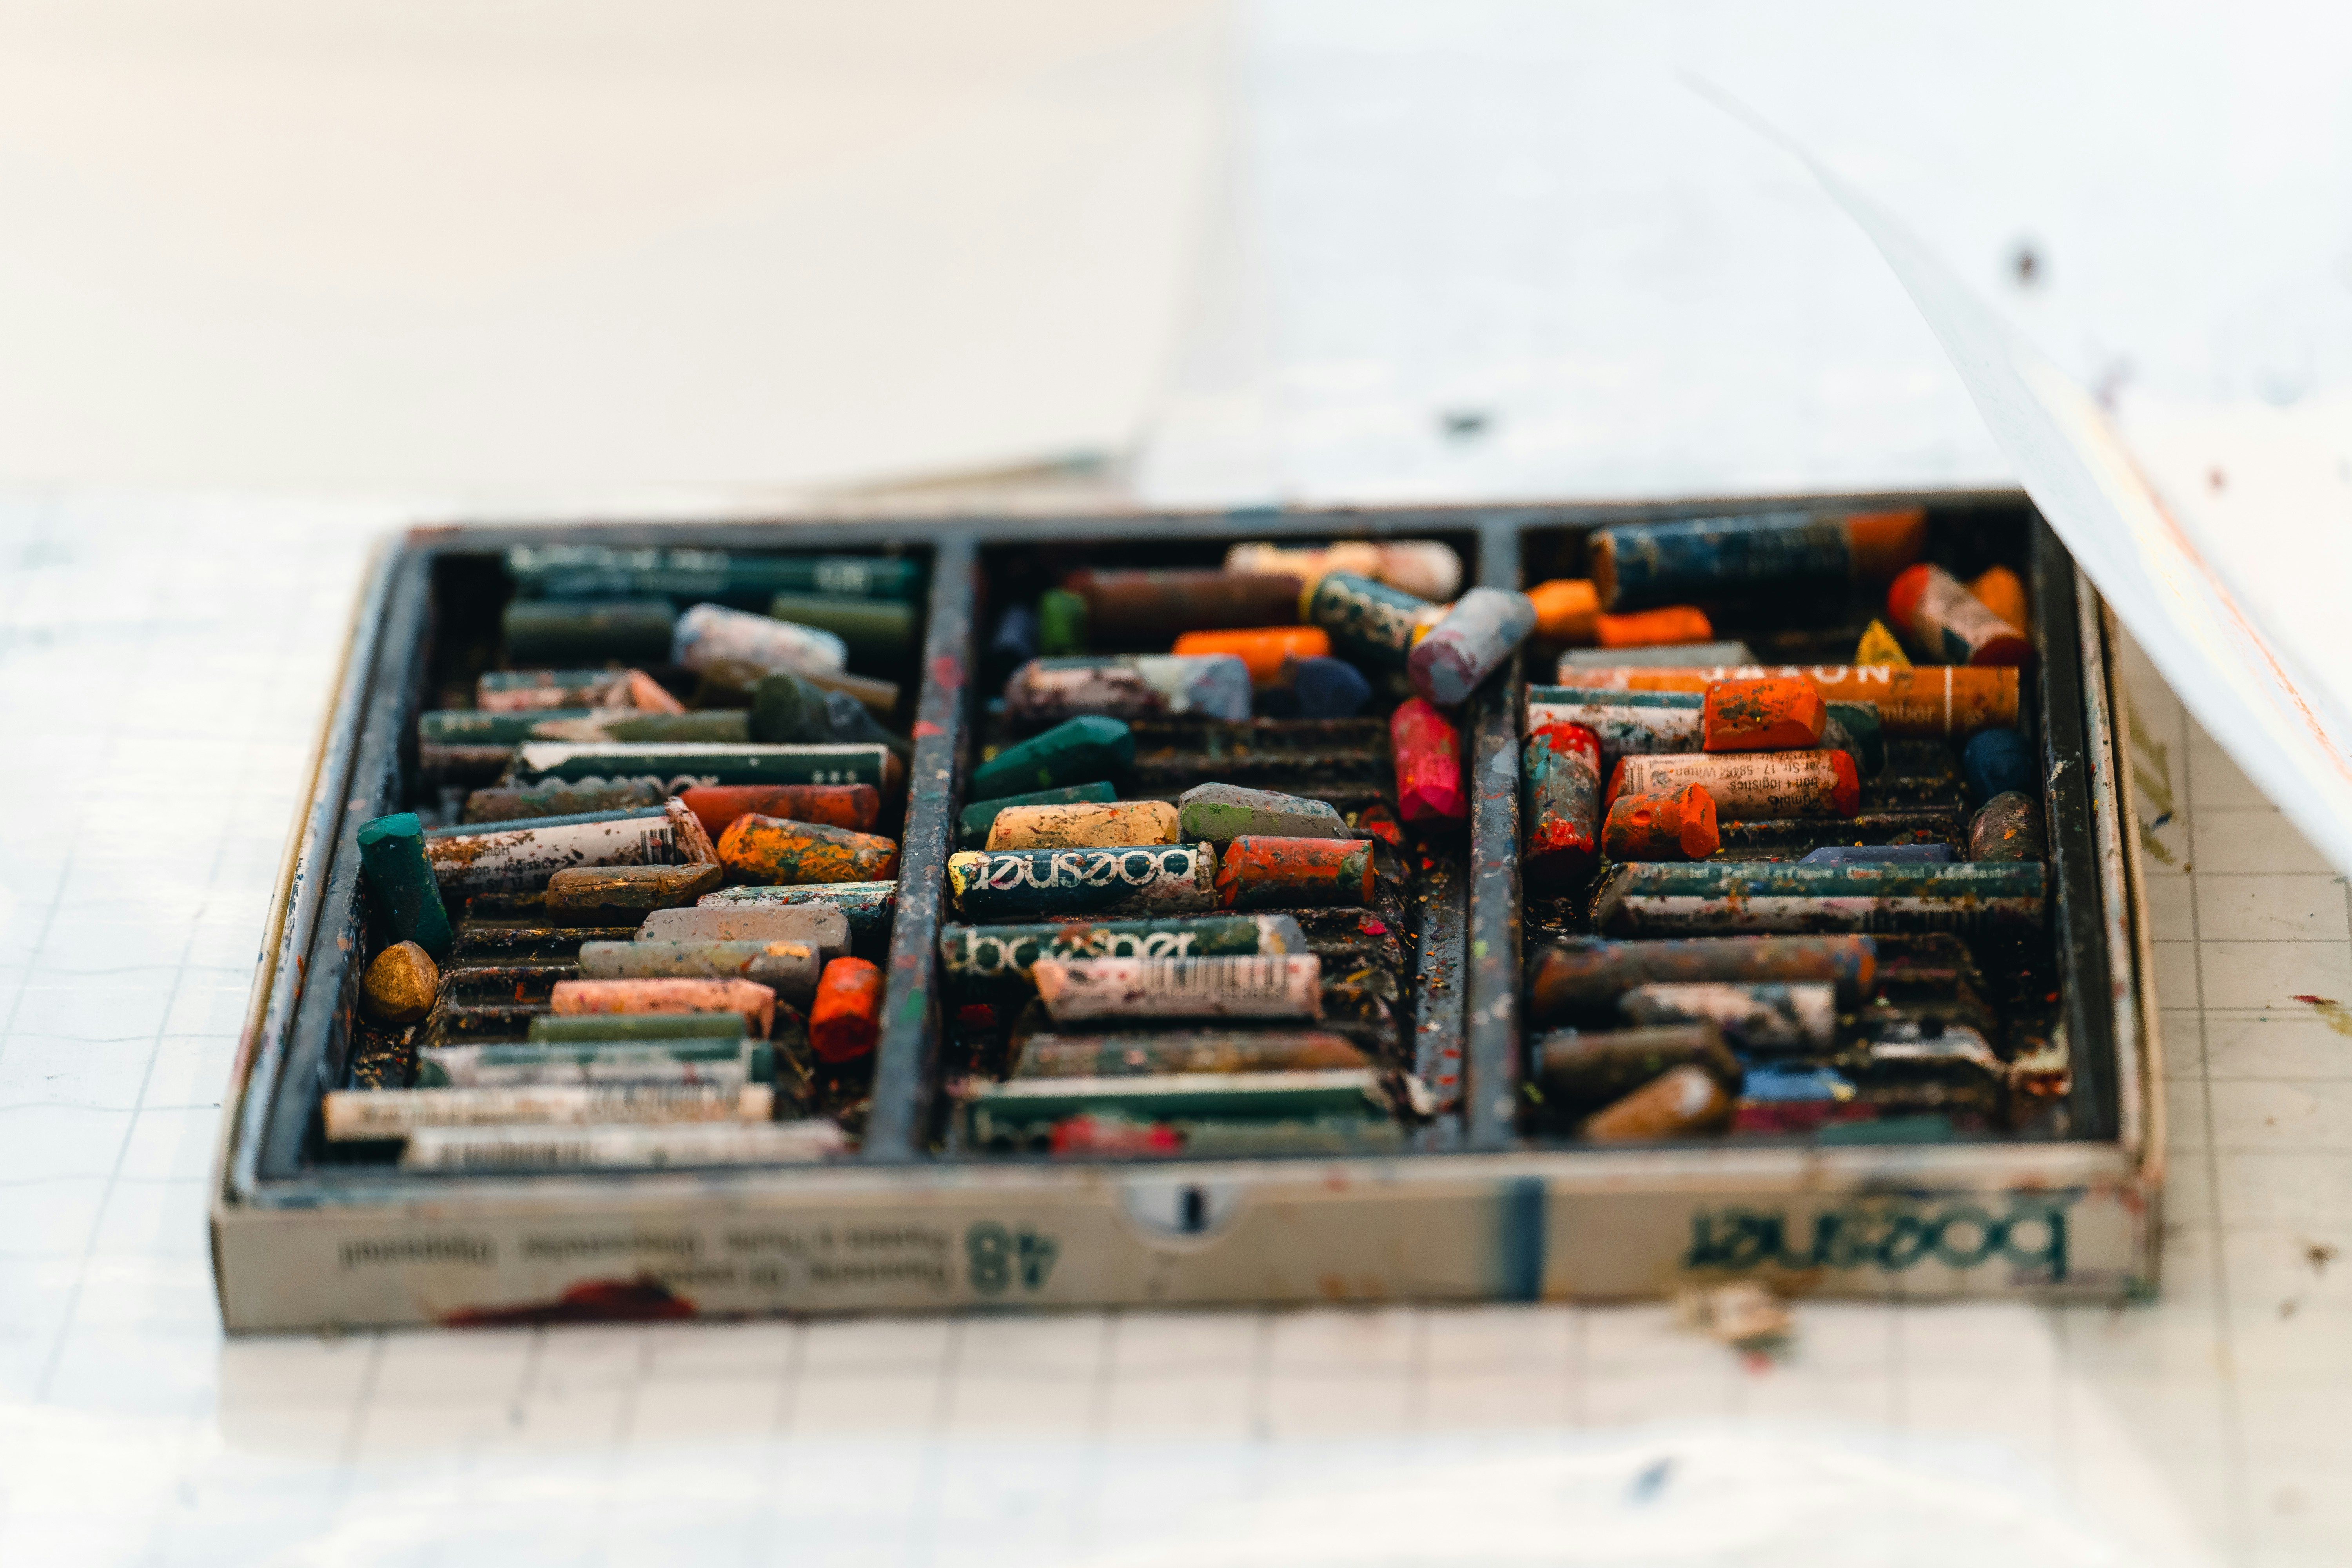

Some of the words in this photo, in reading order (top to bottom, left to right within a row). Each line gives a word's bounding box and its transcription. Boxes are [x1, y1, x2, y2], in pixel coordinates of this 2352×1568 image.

[1764, 764, 1775, 775] 17
[1729, 778, 1780, 793] logistics
[482, 844, 510, 858] mbH
[971, 849, 1198, 891] boesner
[965, 1220, 1061, 1293] 48
